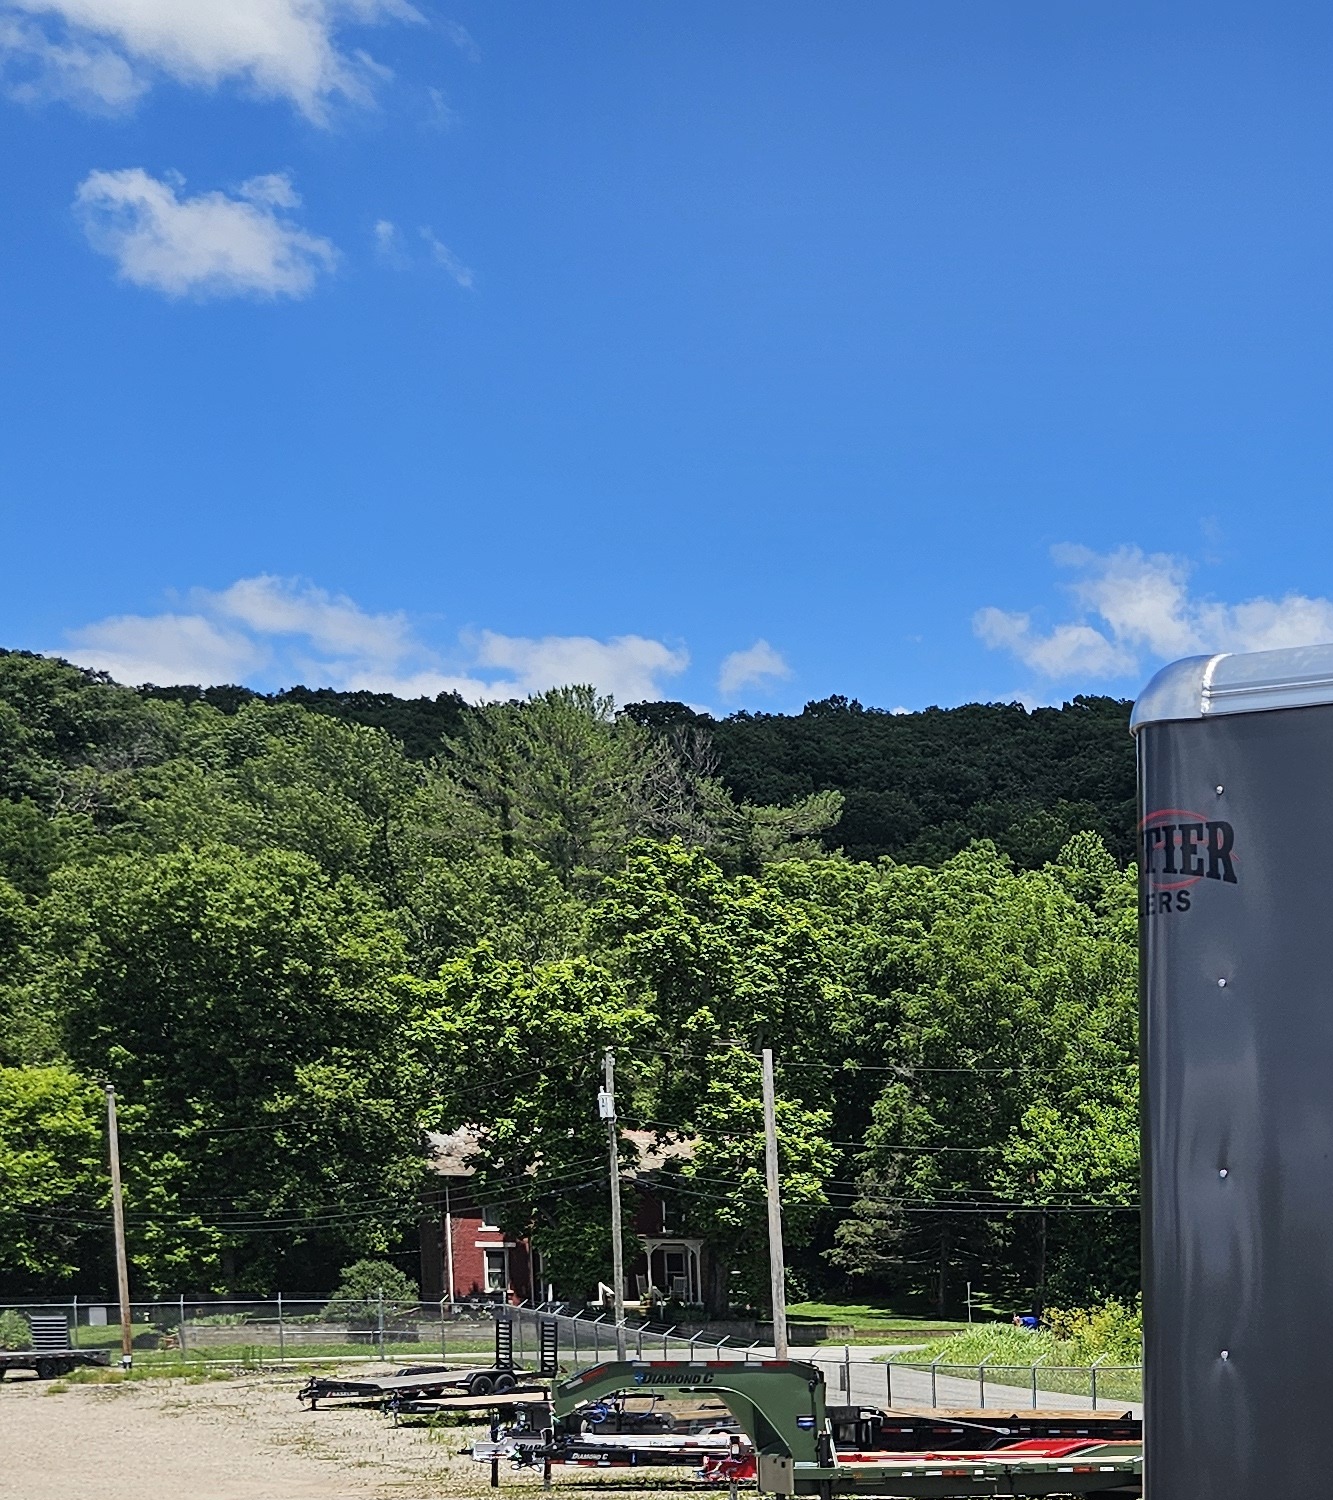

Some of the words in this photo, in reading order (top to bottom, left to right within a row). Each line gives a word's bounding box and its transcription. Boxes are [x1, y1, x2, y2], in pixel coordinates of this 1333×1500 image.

[1140, 889, 1192, 916] ERS
[642, 1373, 702, 1385] DIAMOND
[703, 1372, 715, 1384] C
